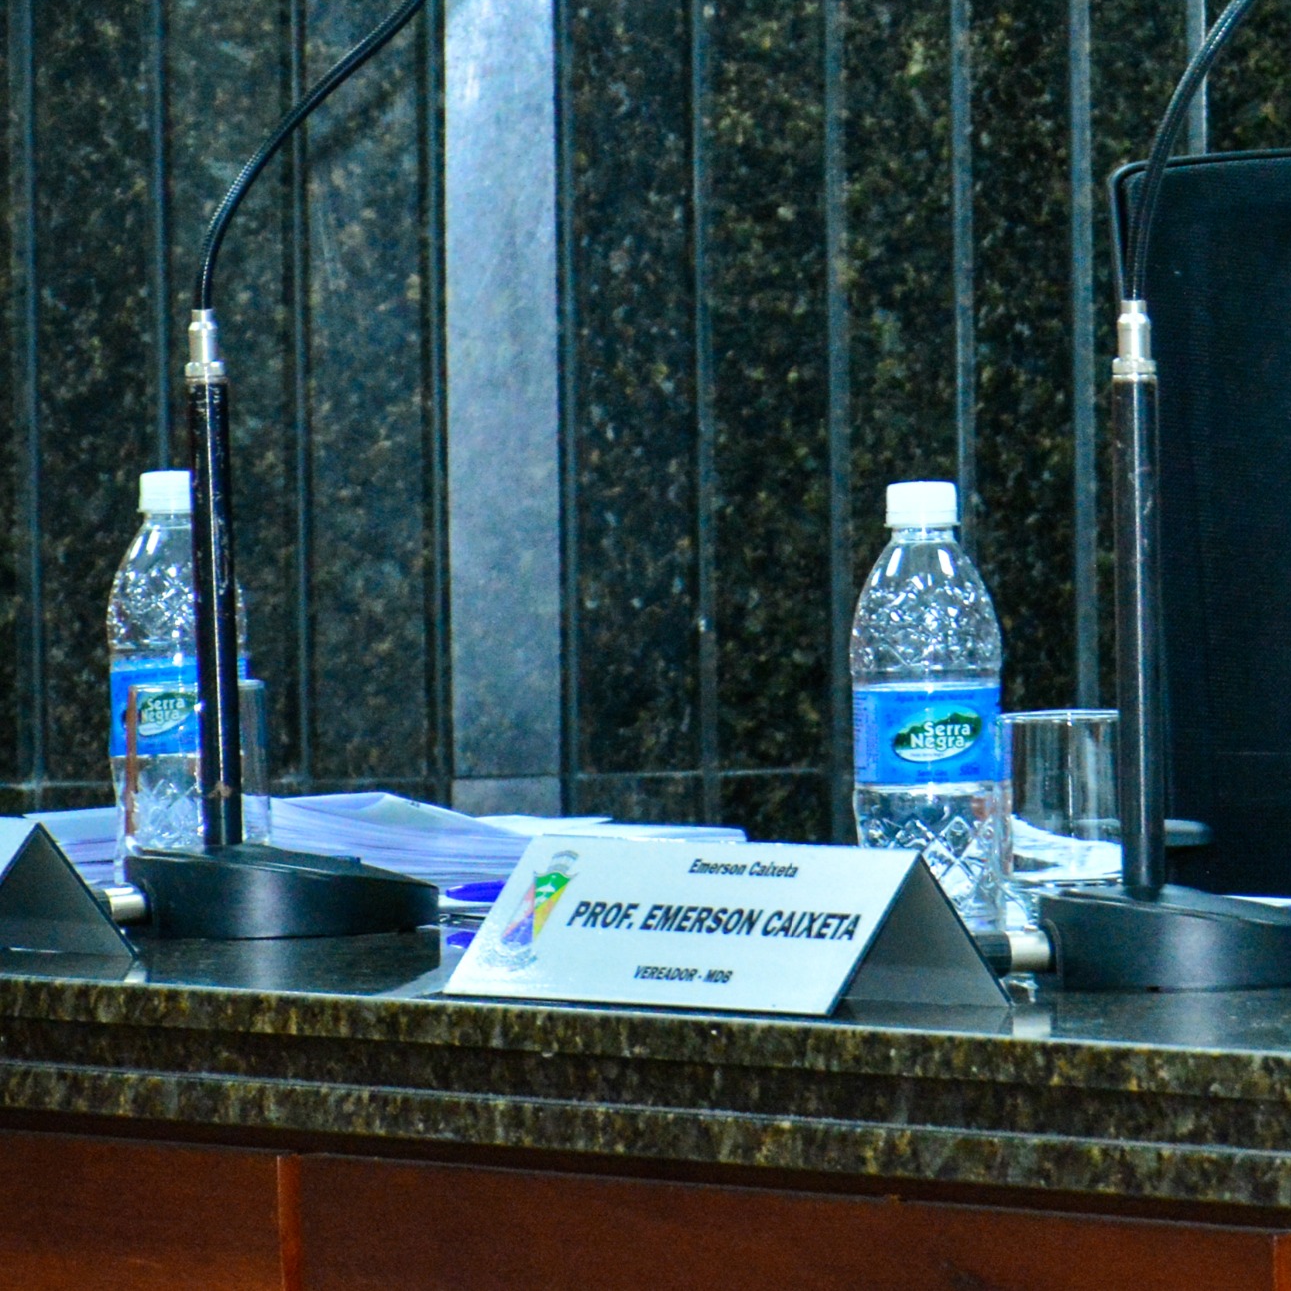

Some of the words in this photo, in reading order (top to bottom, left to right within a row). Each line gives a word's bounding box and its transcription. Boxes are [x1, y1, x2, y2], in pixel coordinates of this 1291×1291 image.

[147, 697, 185, 711] Serra
[923, 721, 971, 737] Serra
[910, 733, 966, 752] Negra
[688, 858, 747, 876] Emerson
[749, 861, 799, 878] Caixeta
[566, 900, 640, 930] PROF.
[639, 904, 764, 937] EMERSON
[761, 910, 862, 941] CAIXETA
[633, 965, 698, 982] VEREADOR
[703, 969, 734, 984] MDB
